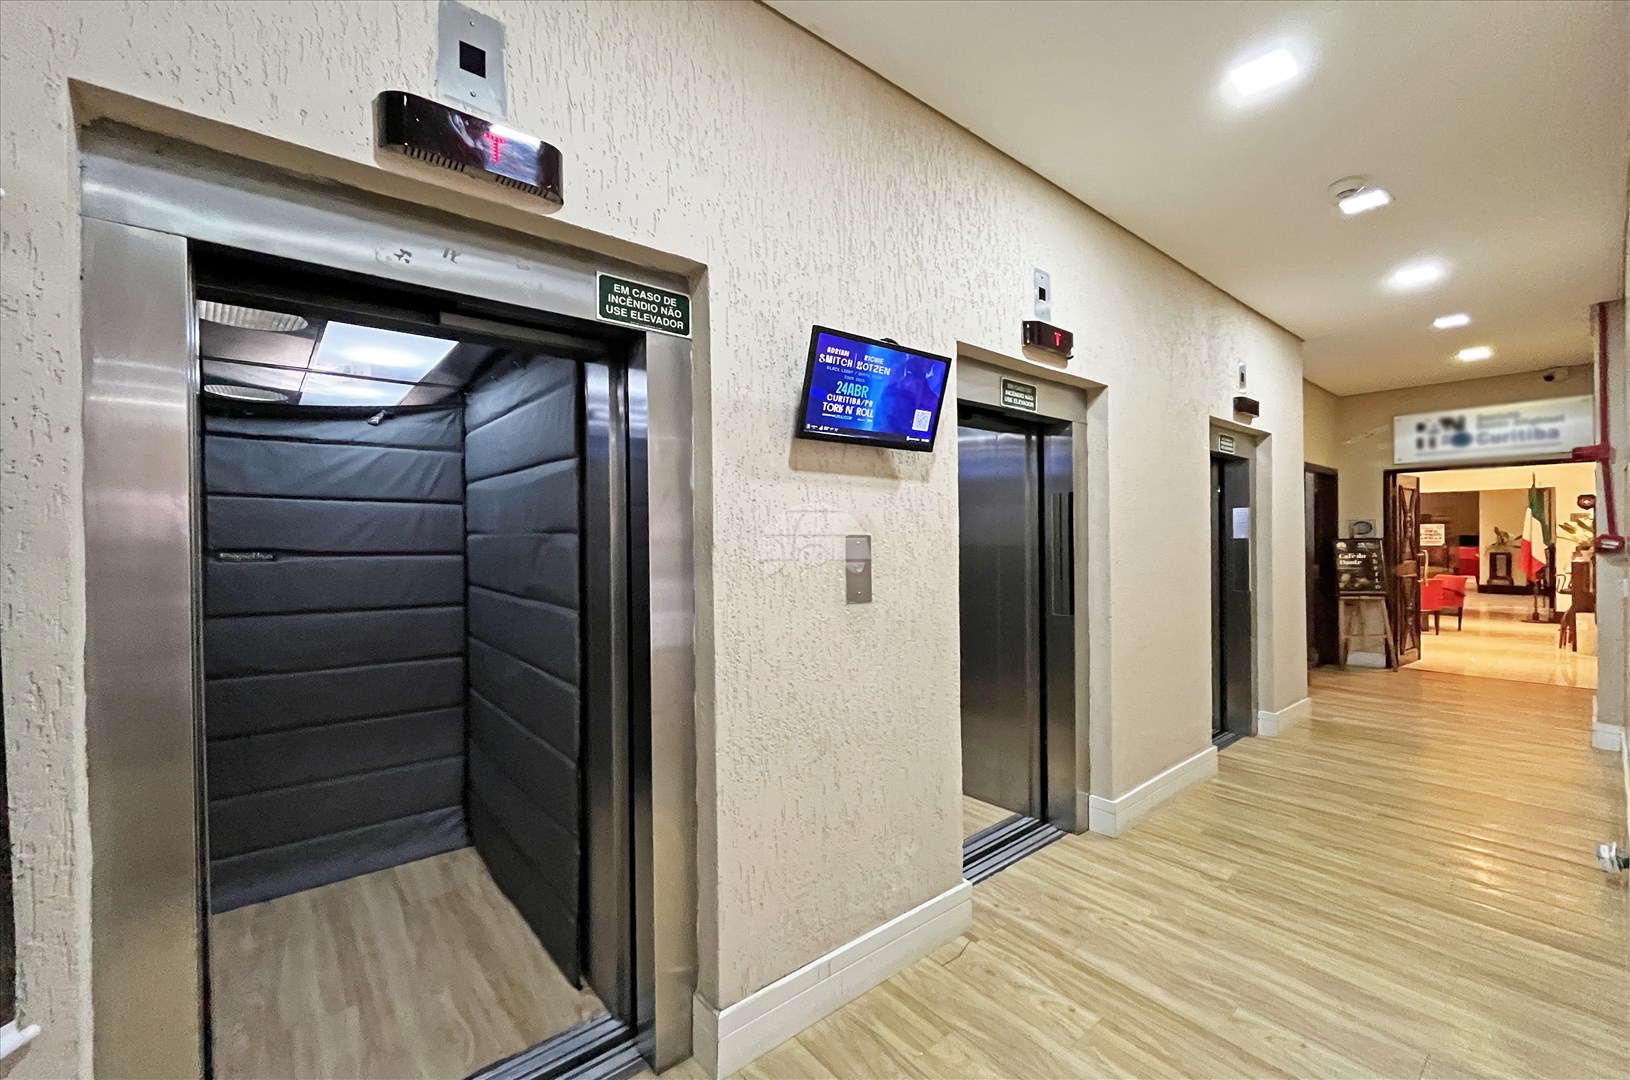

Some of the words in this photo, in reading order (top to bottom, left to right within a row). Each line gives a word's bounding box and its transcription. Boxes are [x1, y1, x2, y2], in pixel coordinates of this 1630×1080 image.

[483, 131, 507, 164] T
[613, 283, 630, 295] EM
[632, 288, 661, 303] CASO
[663, 296, 677, 307] DE
[607, 293, 658, 313] INCÊNDIO
[660, 306, 682, 318] NÃO
[605, 304, 628, 317] USE
[630, 310, 684, 330] ELEVADOR
[1054, 332, 1062, 347] T
[827, 346, 850, 357] ADRIAN
[835, 380, 870, 398] 24ABR
[826, 393, 873, 408] CURITIBA/PR
[855, 407, 874, 418] ROLL
